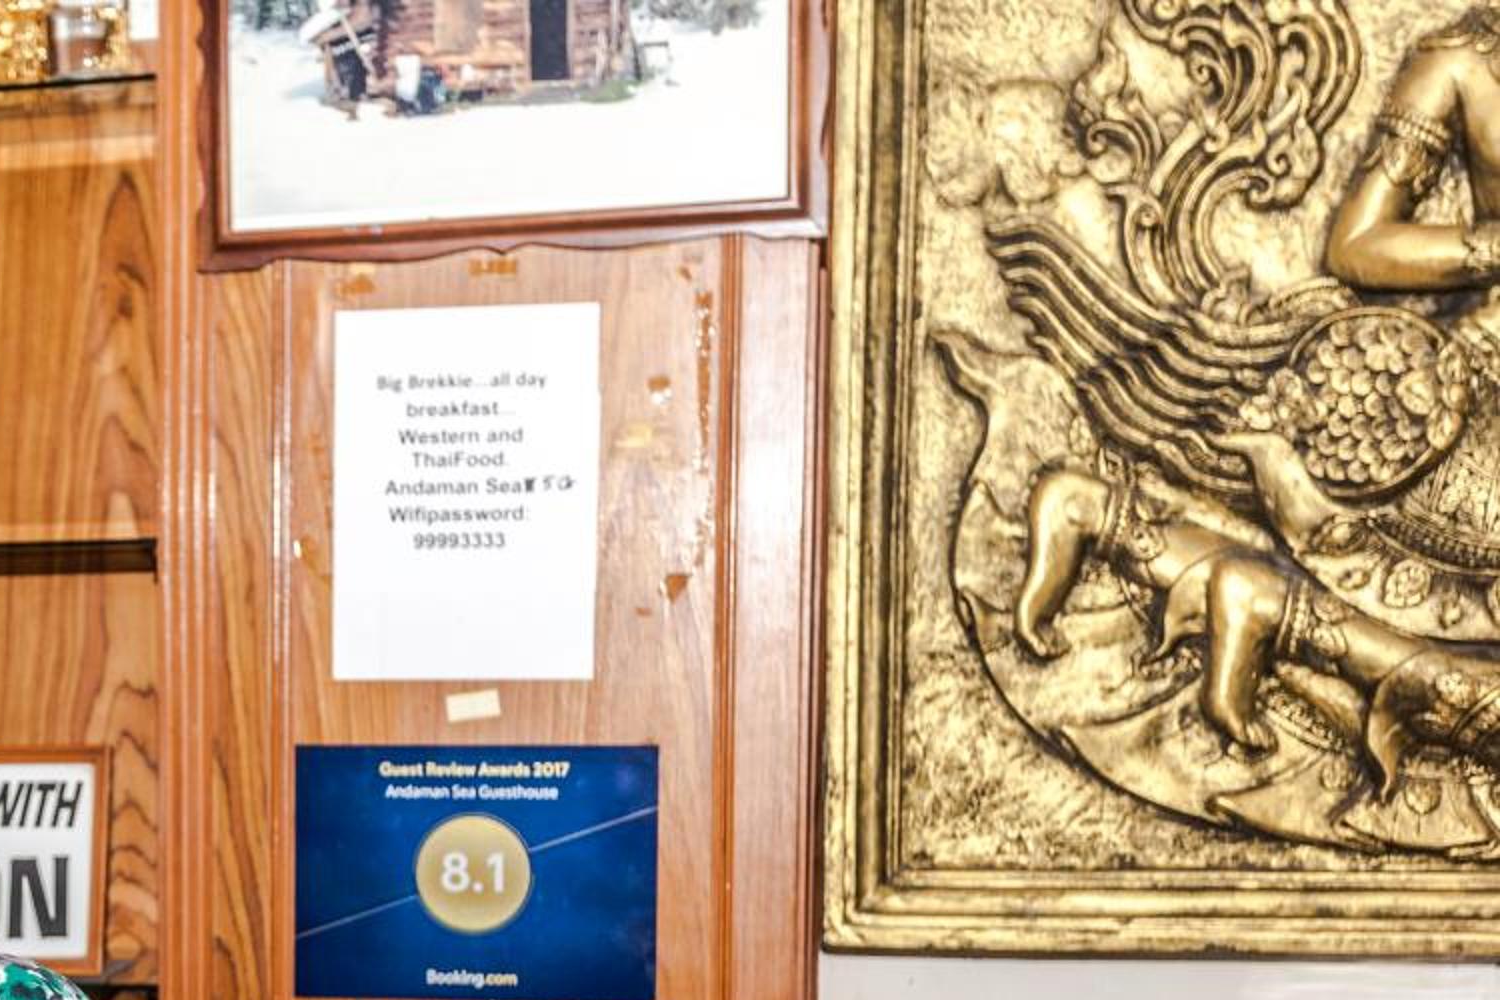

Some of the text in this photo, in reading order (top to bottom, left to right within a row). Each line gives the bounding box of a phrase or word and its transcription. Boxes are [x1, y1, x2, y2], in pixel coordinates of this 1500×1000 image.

[377, 375, 402, 393] Big
[516, 371, 546, 389] day
[398, 427, 524, 445] Western and
[384, 479, 478, 497] Andaman
[413, 532, 506, 550] 99993333
[378, 761, 570, 778] Guest Review Awards 2017
[385, 784, 559, 800] Andaman Sea Guesthouse
[440, 852, 507, 893] 8.1
[425, 969, 518, 989] Booking.com
